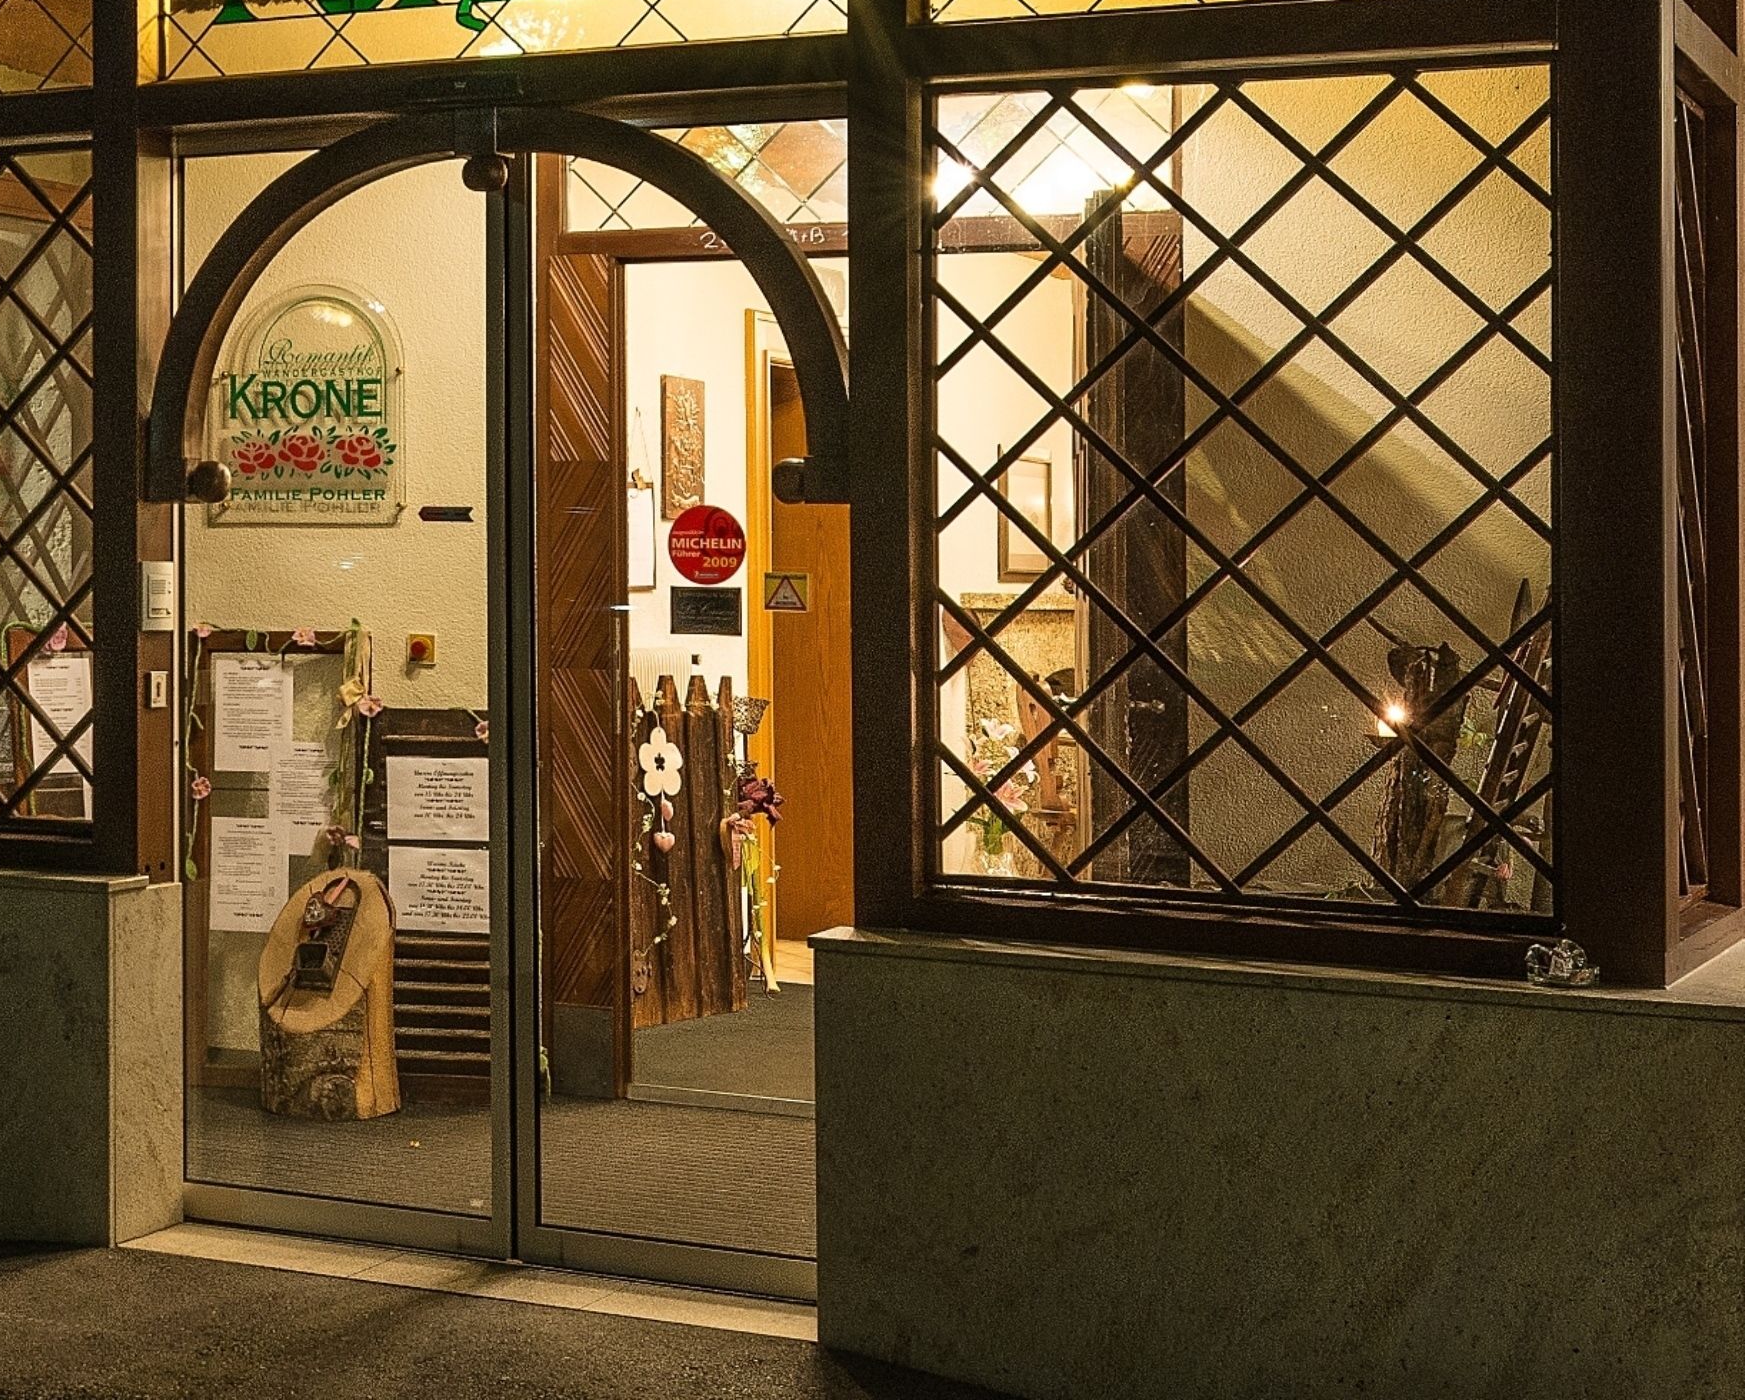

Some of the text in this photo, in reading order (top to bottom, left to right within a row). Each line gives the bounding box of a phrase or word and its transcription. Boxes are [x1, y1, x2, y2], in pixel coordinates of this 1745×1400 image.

[263, 338, 377, 365] Romantik
[228, 373, 383, 420] KRONE
[230, 486, 386, 501] FAMILIE POHLER
[671, 537, 742, 549] MICHELIN
[671, 549, 702, 558] Führer
[703, 556, 737, 568] 2009
